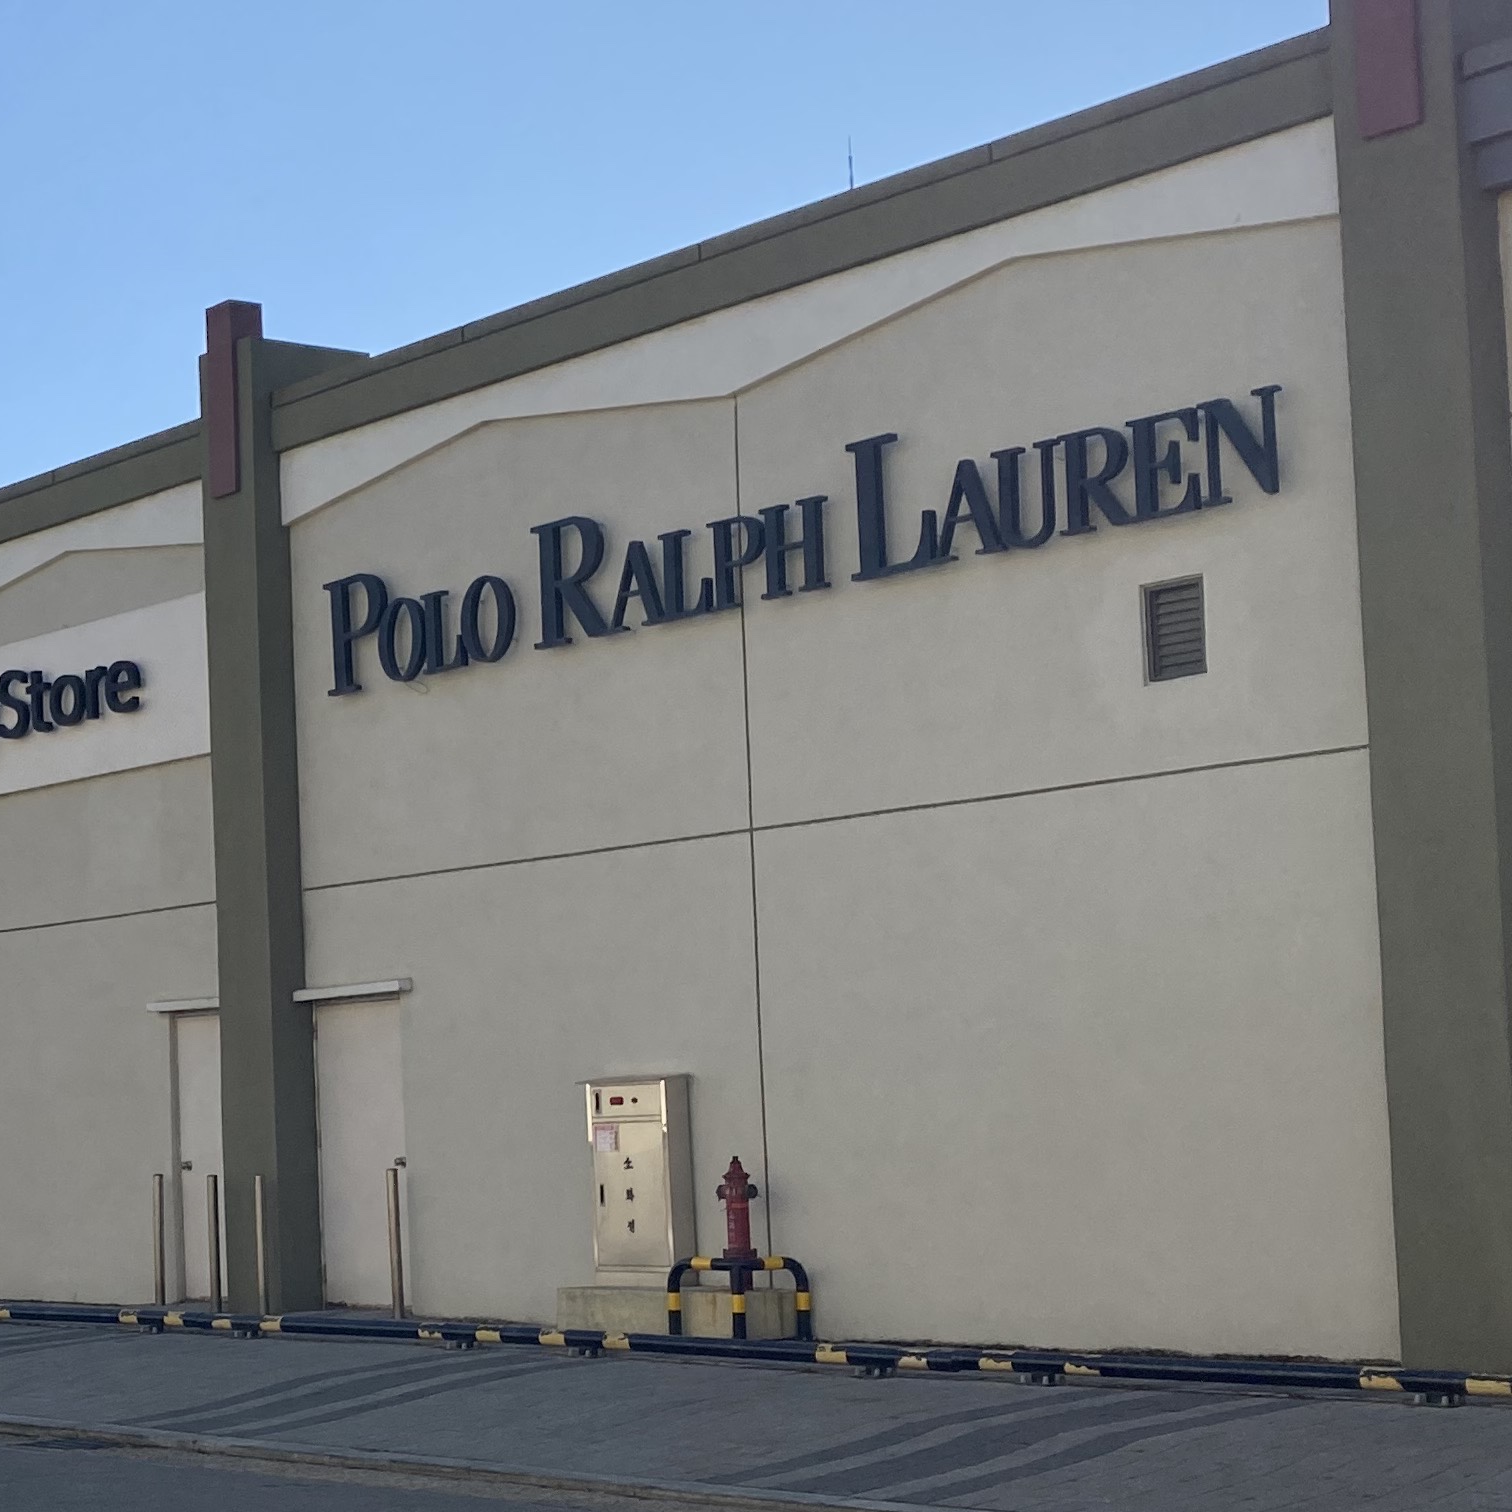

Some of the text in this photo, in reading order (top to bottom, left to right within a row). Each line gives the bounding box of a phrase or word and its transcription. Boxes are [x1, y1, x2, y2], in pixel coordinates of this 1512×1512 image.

[322, 384, 1283, 697] POLO RALPH LAUREN
